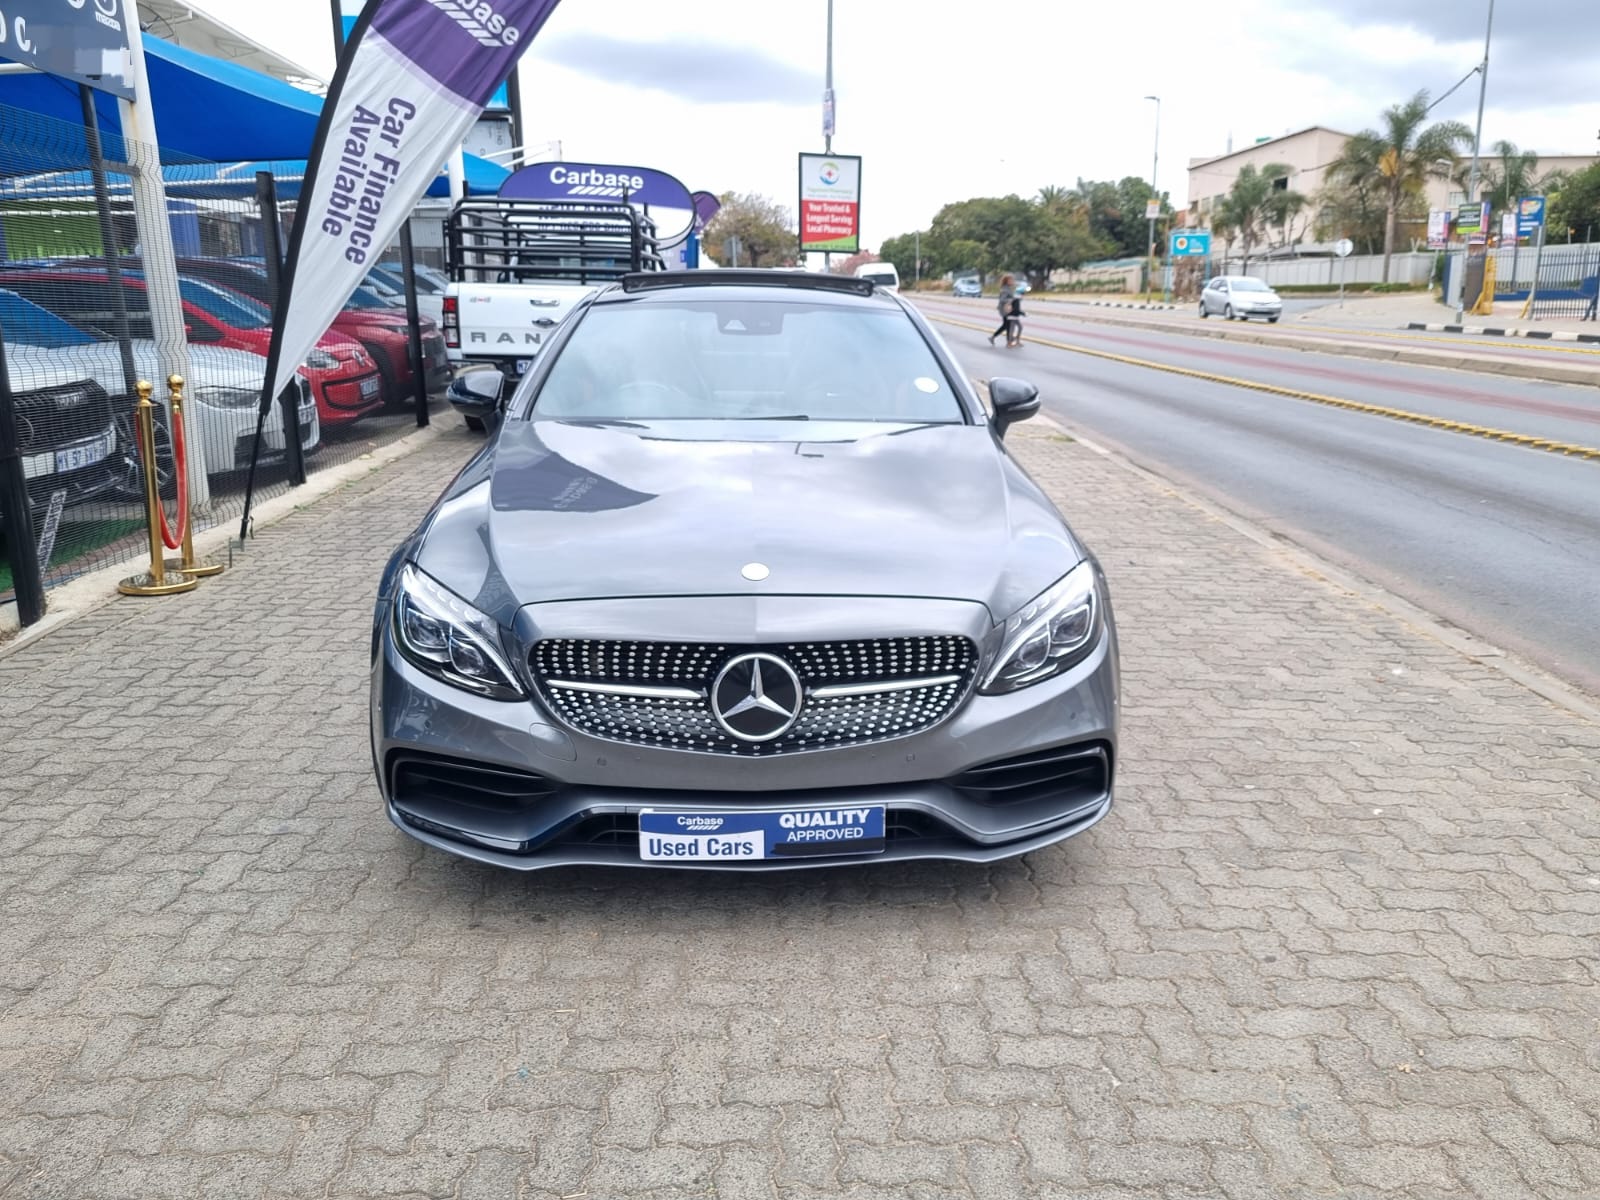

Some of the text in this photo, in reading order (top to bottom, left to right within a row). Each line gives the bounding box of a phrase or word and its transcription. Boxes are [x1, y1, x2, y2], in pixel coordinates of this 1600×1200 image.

[321, 104, 381, 237] Available
[550, 166, 644, 189] Carbase
[345, 97, 416, 265] Car Finance
[808, 202, 823, 212] Your
[831, 214, 853, 226] Serving
[806, 224, 853, 236] Local Pharmacy
[677, 816, 724, 826] Carbase
[779, 809, 870, 829] QUALITY
[787, 828, 864, 842] APPROVED
[649, 838, 753, 856] Used Cars
